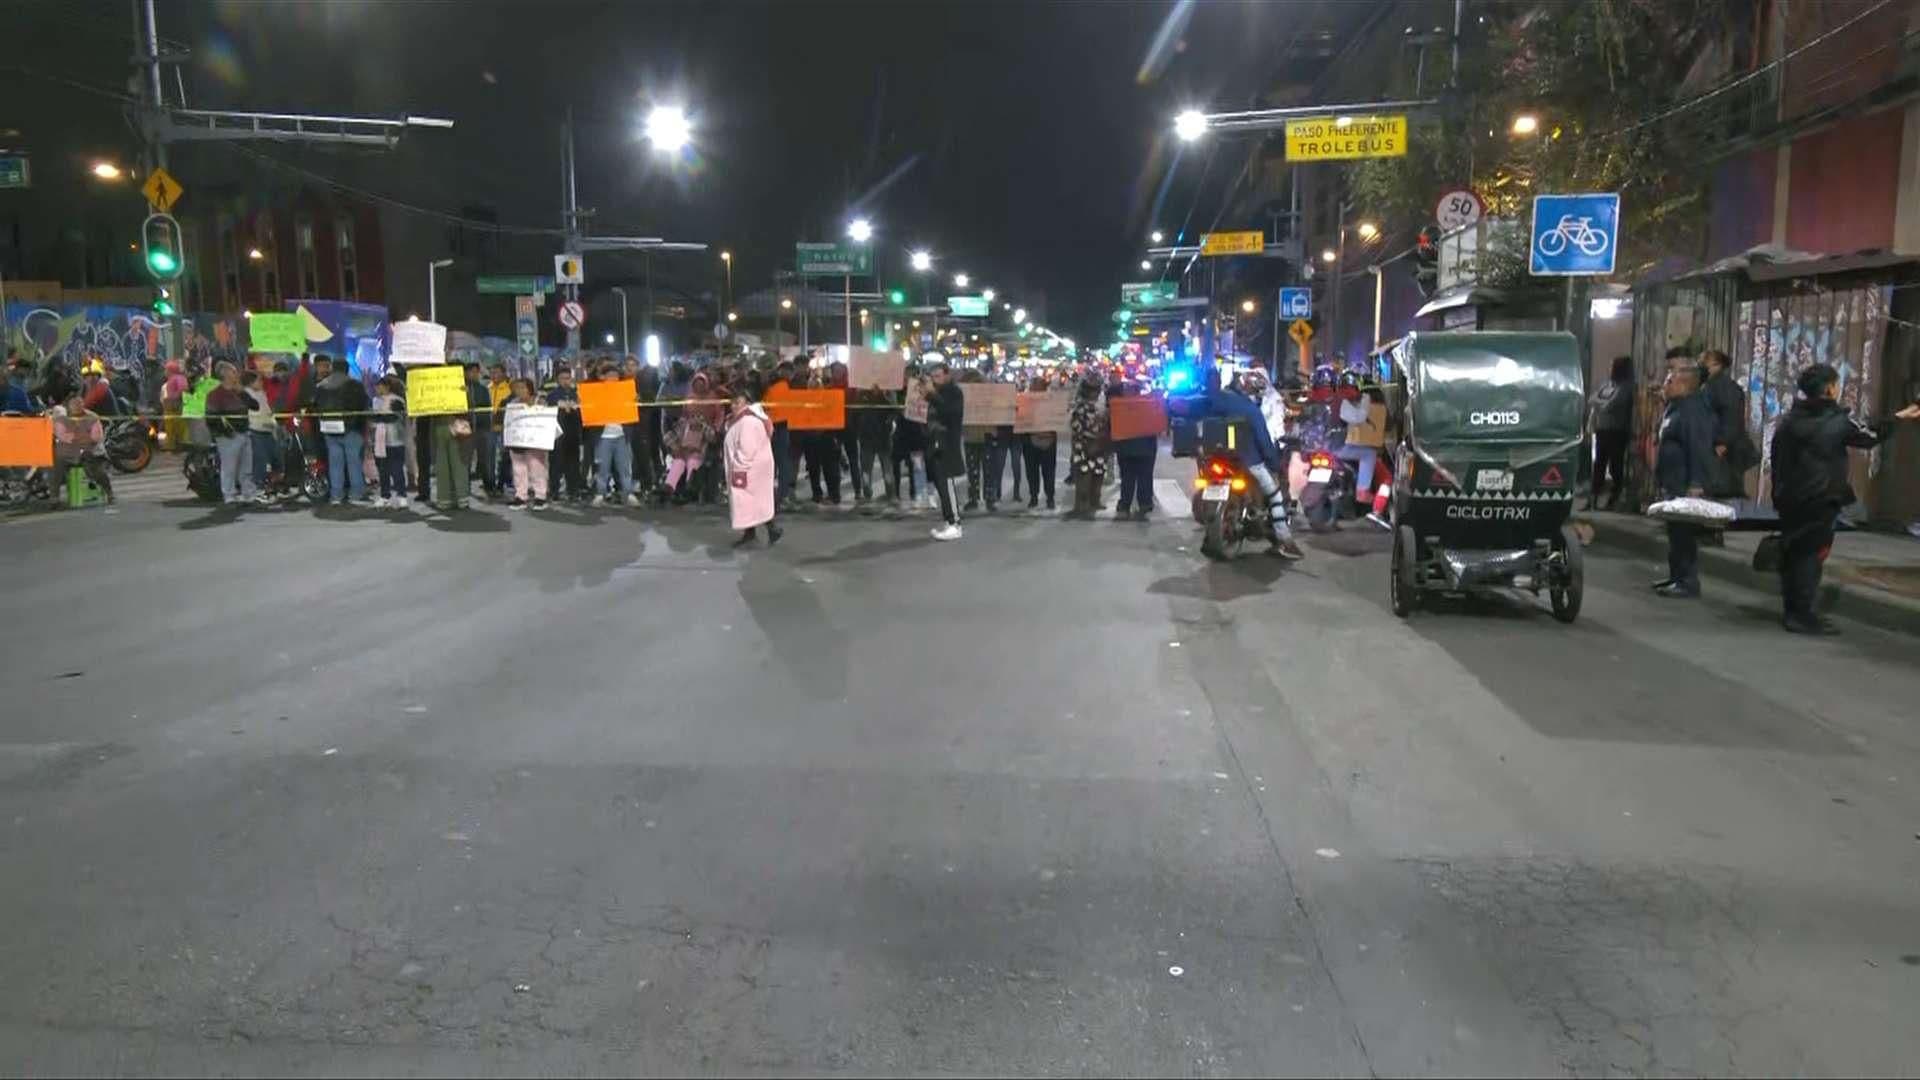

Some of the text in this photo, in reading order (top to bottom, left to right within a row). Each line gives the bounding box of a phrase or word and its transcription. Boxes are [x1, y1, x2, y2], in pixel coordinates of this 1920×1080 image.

[1293, 120, 1399, 138] PASO PREFERENTE
[1298, 138, 1395, 155] TROLEBUS
[1448, 197, 1472, 217] 50
[1446, 504, 1531, 520] CICLOTAXI
